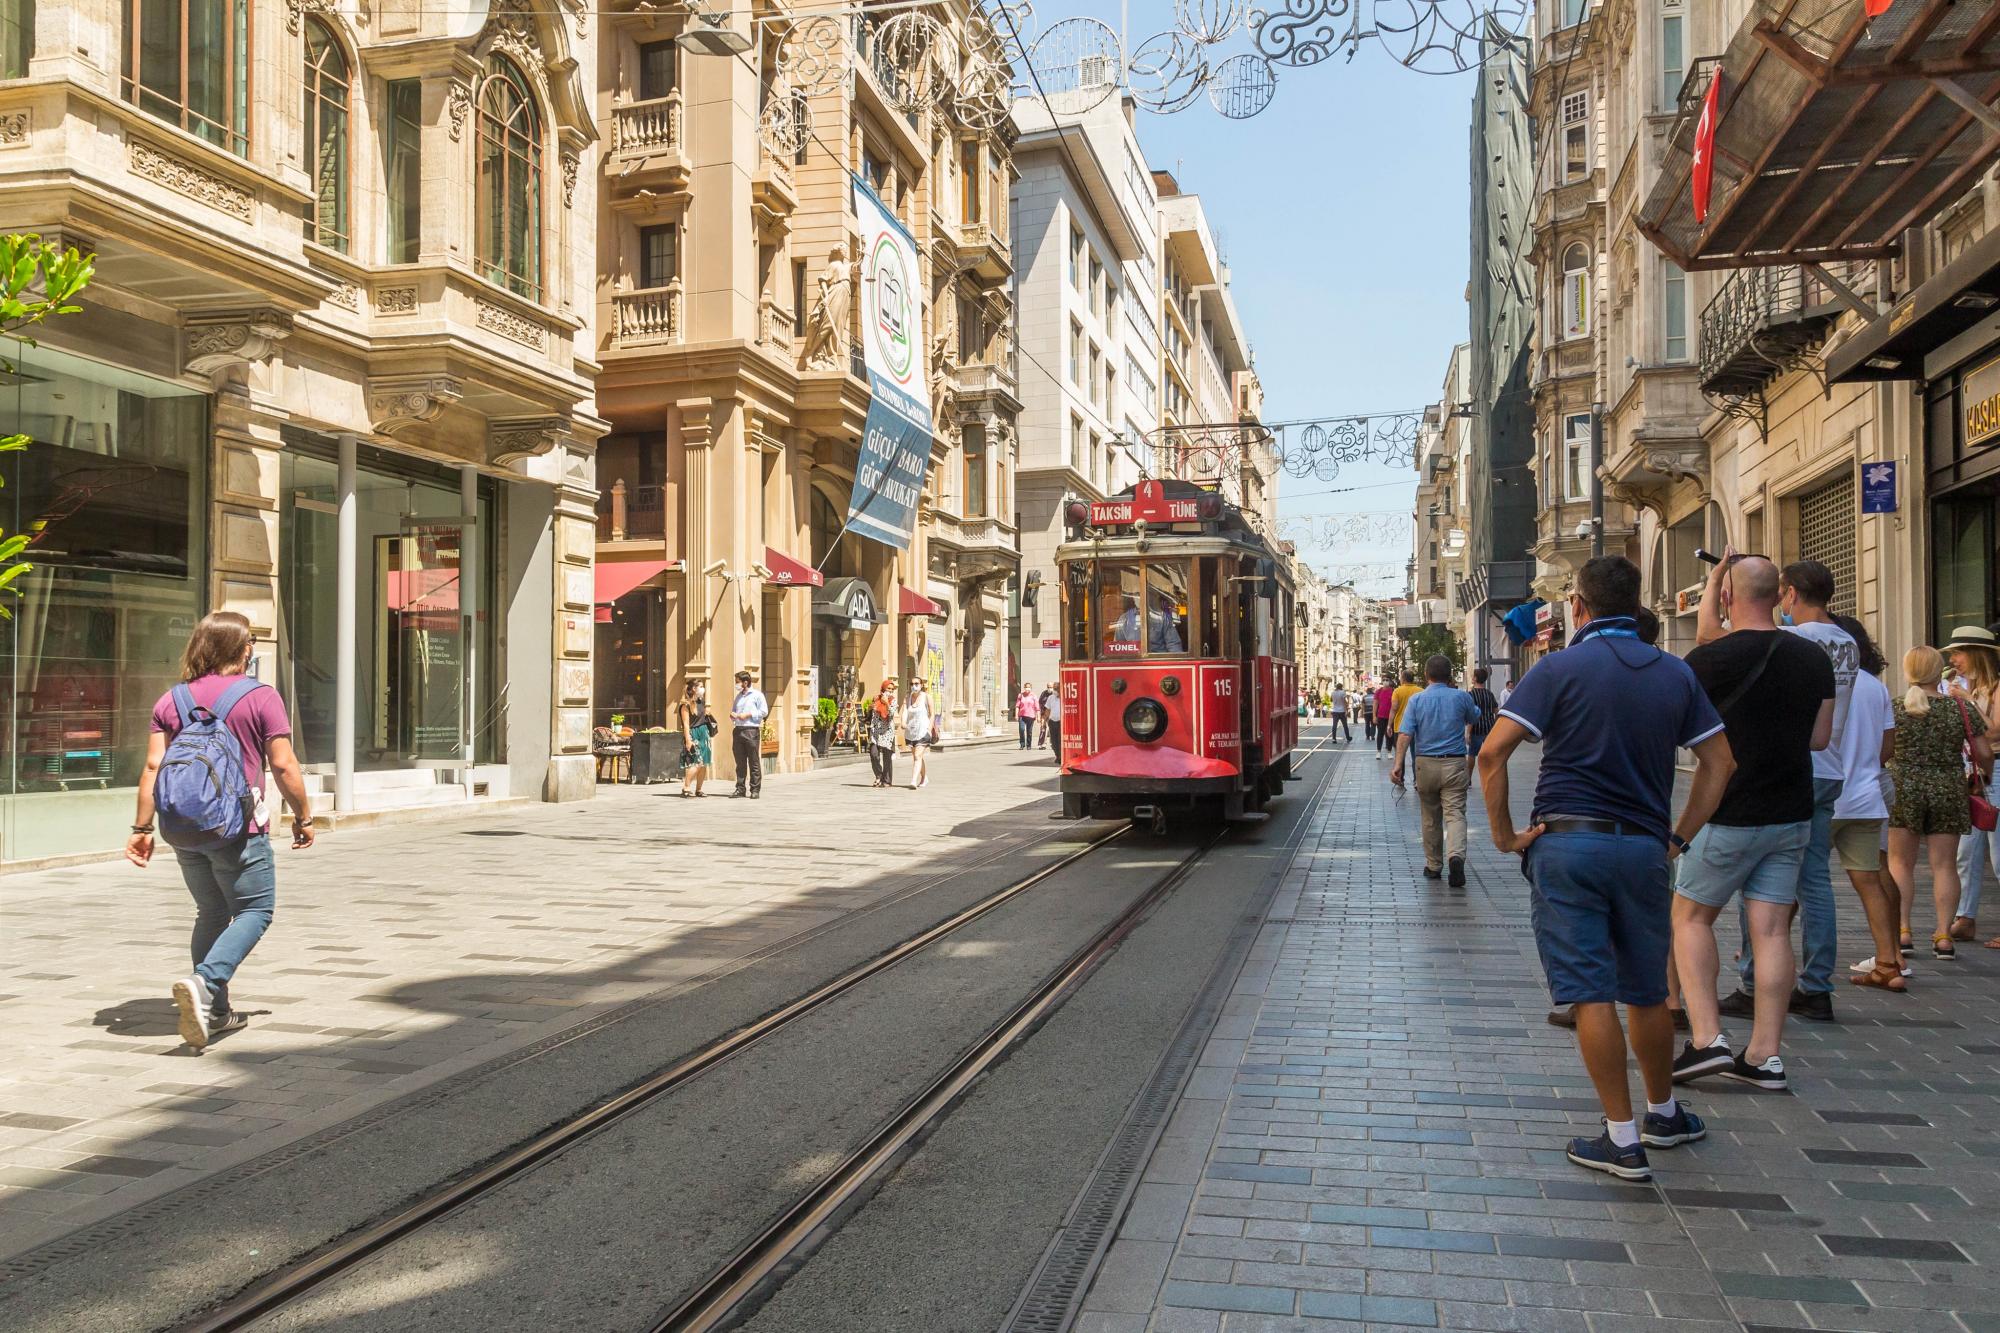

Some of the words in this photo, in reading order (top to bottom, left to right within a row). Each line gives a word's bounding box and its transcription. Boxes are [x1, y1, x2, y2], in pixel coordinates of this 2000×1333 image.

[898, 447, 923, 478] BARO
[883, 478, 919, 509] AVUKAT
[1143, 481, 1153, 498] 4
[1093, 505, 1132, 521] TAKSİM
[1169, 501, 1197, 518] TÜNE
[777, 571, 792, 579] ADA
[852, 592, 871, 620] ADA
[1109, 643, 1140, 652] TÜNEL
[1064, 682, 1078, 699] 115
[1213, 678, 1232, 697] 115
